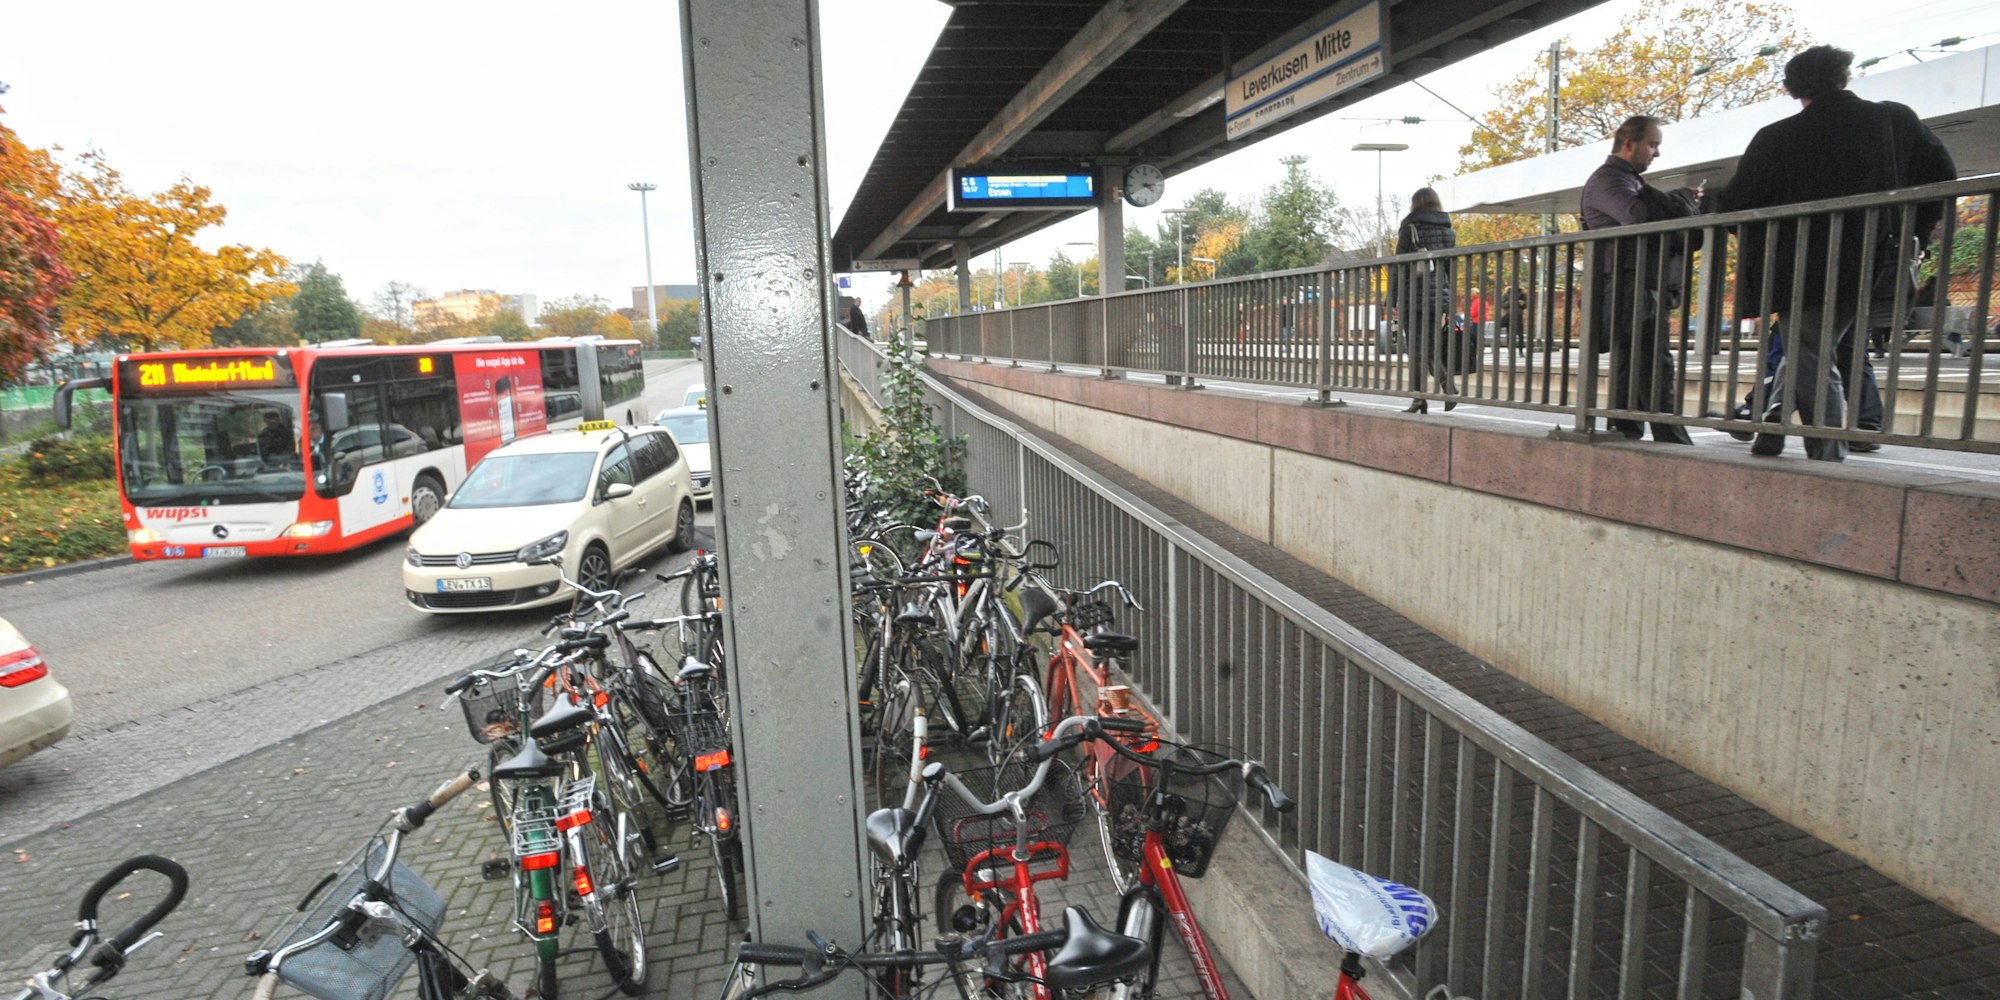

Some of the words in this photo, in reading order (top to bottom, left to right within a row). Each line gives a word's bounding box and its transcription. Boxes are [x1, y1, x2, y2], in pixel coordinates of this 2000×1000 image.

[1242, 52, 1309, 101] Leverkusen
[1314, 29, 1352, 64] Mitte
[1335, 63, 1370, 86] Zentrum
[1085, 176, 1093, 192] 1
[987, 188, 1012, 197] Essen
[146, 507, 208, 522] wupsi
